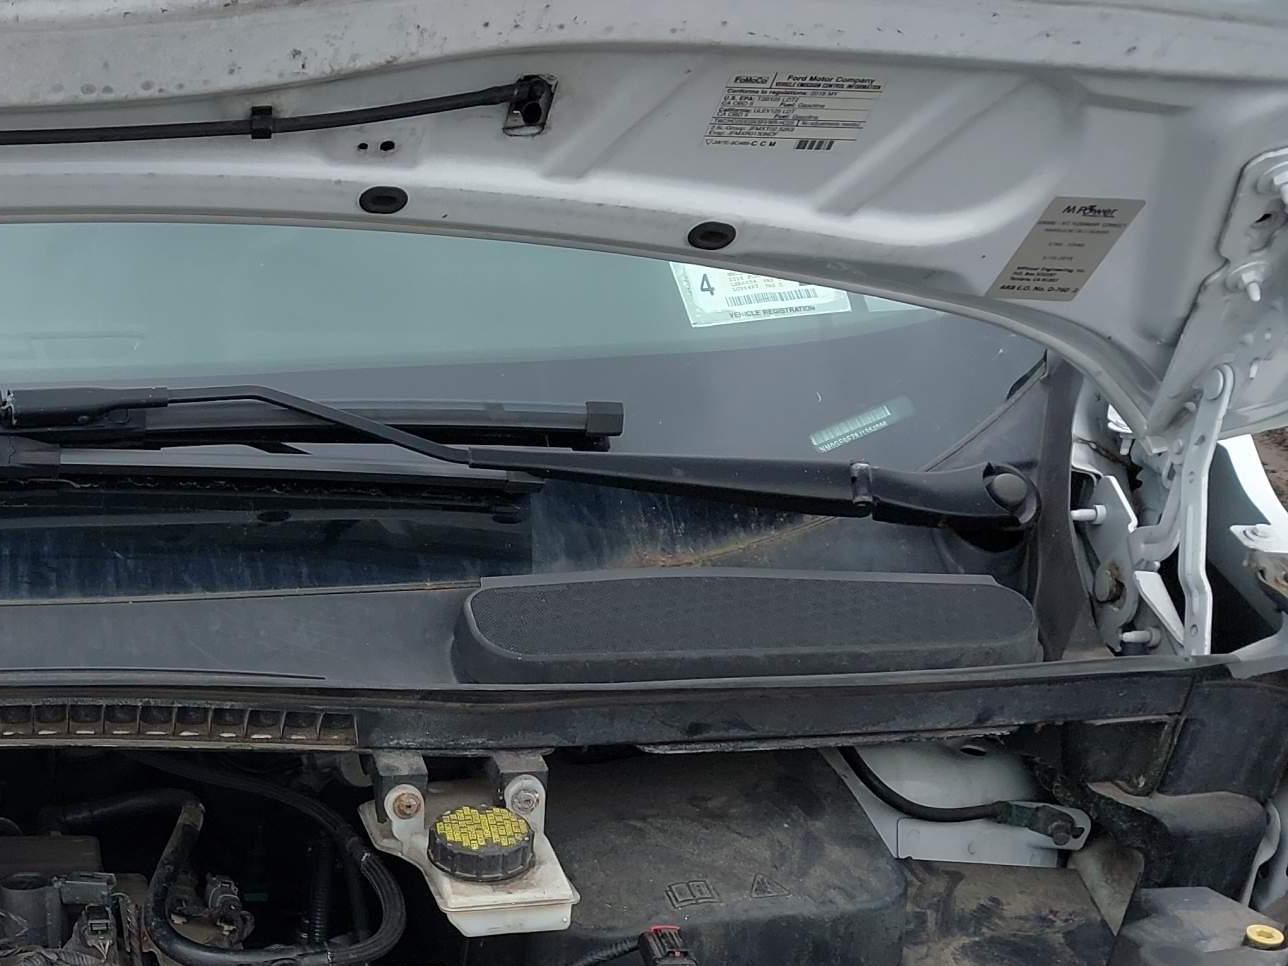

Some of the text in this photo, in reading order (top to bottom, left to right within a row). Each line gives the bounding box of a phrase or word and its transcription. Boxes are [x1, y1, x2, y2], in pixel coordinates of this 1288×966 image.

[734, 75, 768, 84] FoMoCo
[700, 273, 715, 296] 4
[729, 305, 816, 318] VEHICLE REGISTRATION
